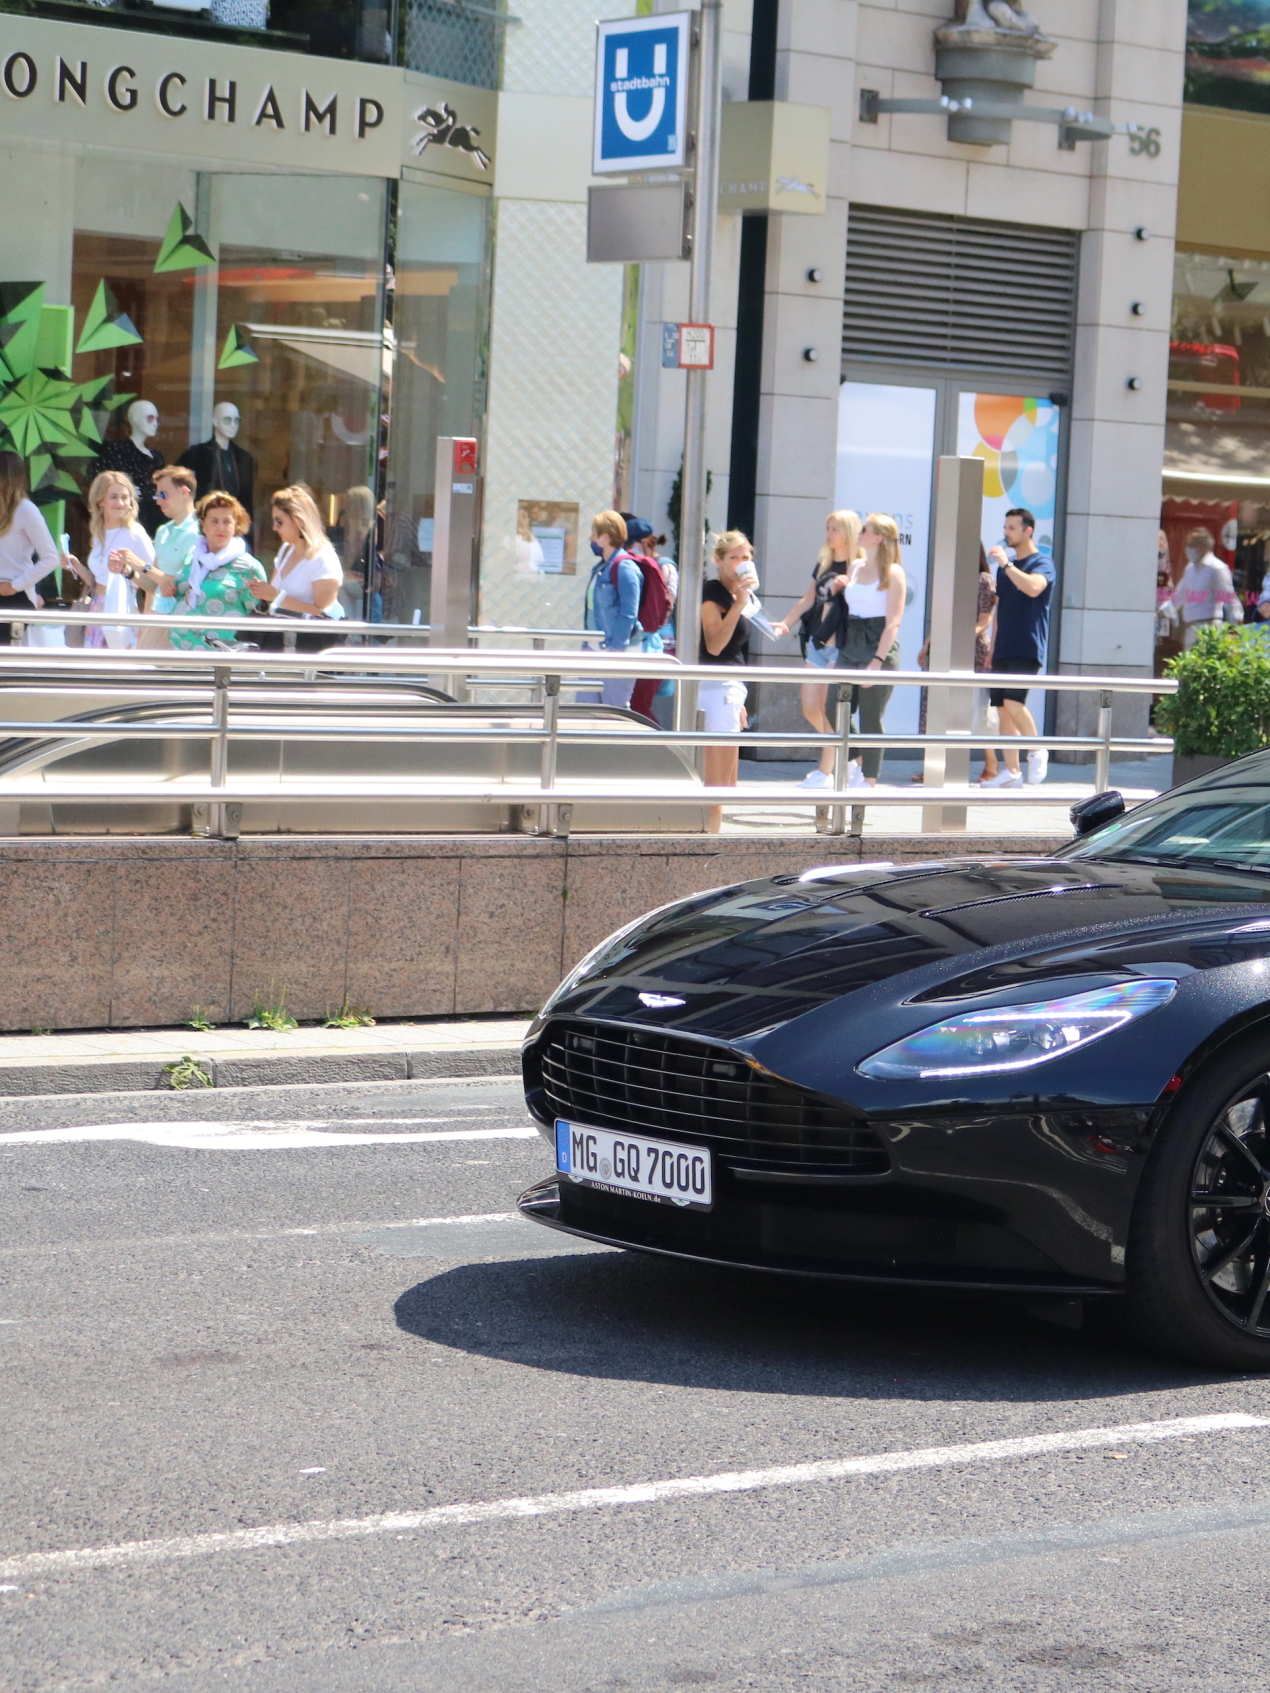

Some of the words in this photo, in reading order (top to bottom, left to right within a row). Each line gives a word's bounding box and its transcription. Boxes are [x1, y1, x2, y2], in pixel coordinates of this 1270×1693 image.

[2, 51, 385, 139] ONGCHAMP
[610, 75, 670, 92] stadtbahn
[1129, 126, 1161, 158] 56
[562, 1152, 568, 1163] D
[572, 1131, 598, 1173] MG
[613, 1140, 640, 1183] GQ
[646, 1146, 705, 1195] 7000
[591, 1181, 610, 1192] ASTON
[609, 1185, 662, 1203] MARTIN-KOELN.de
